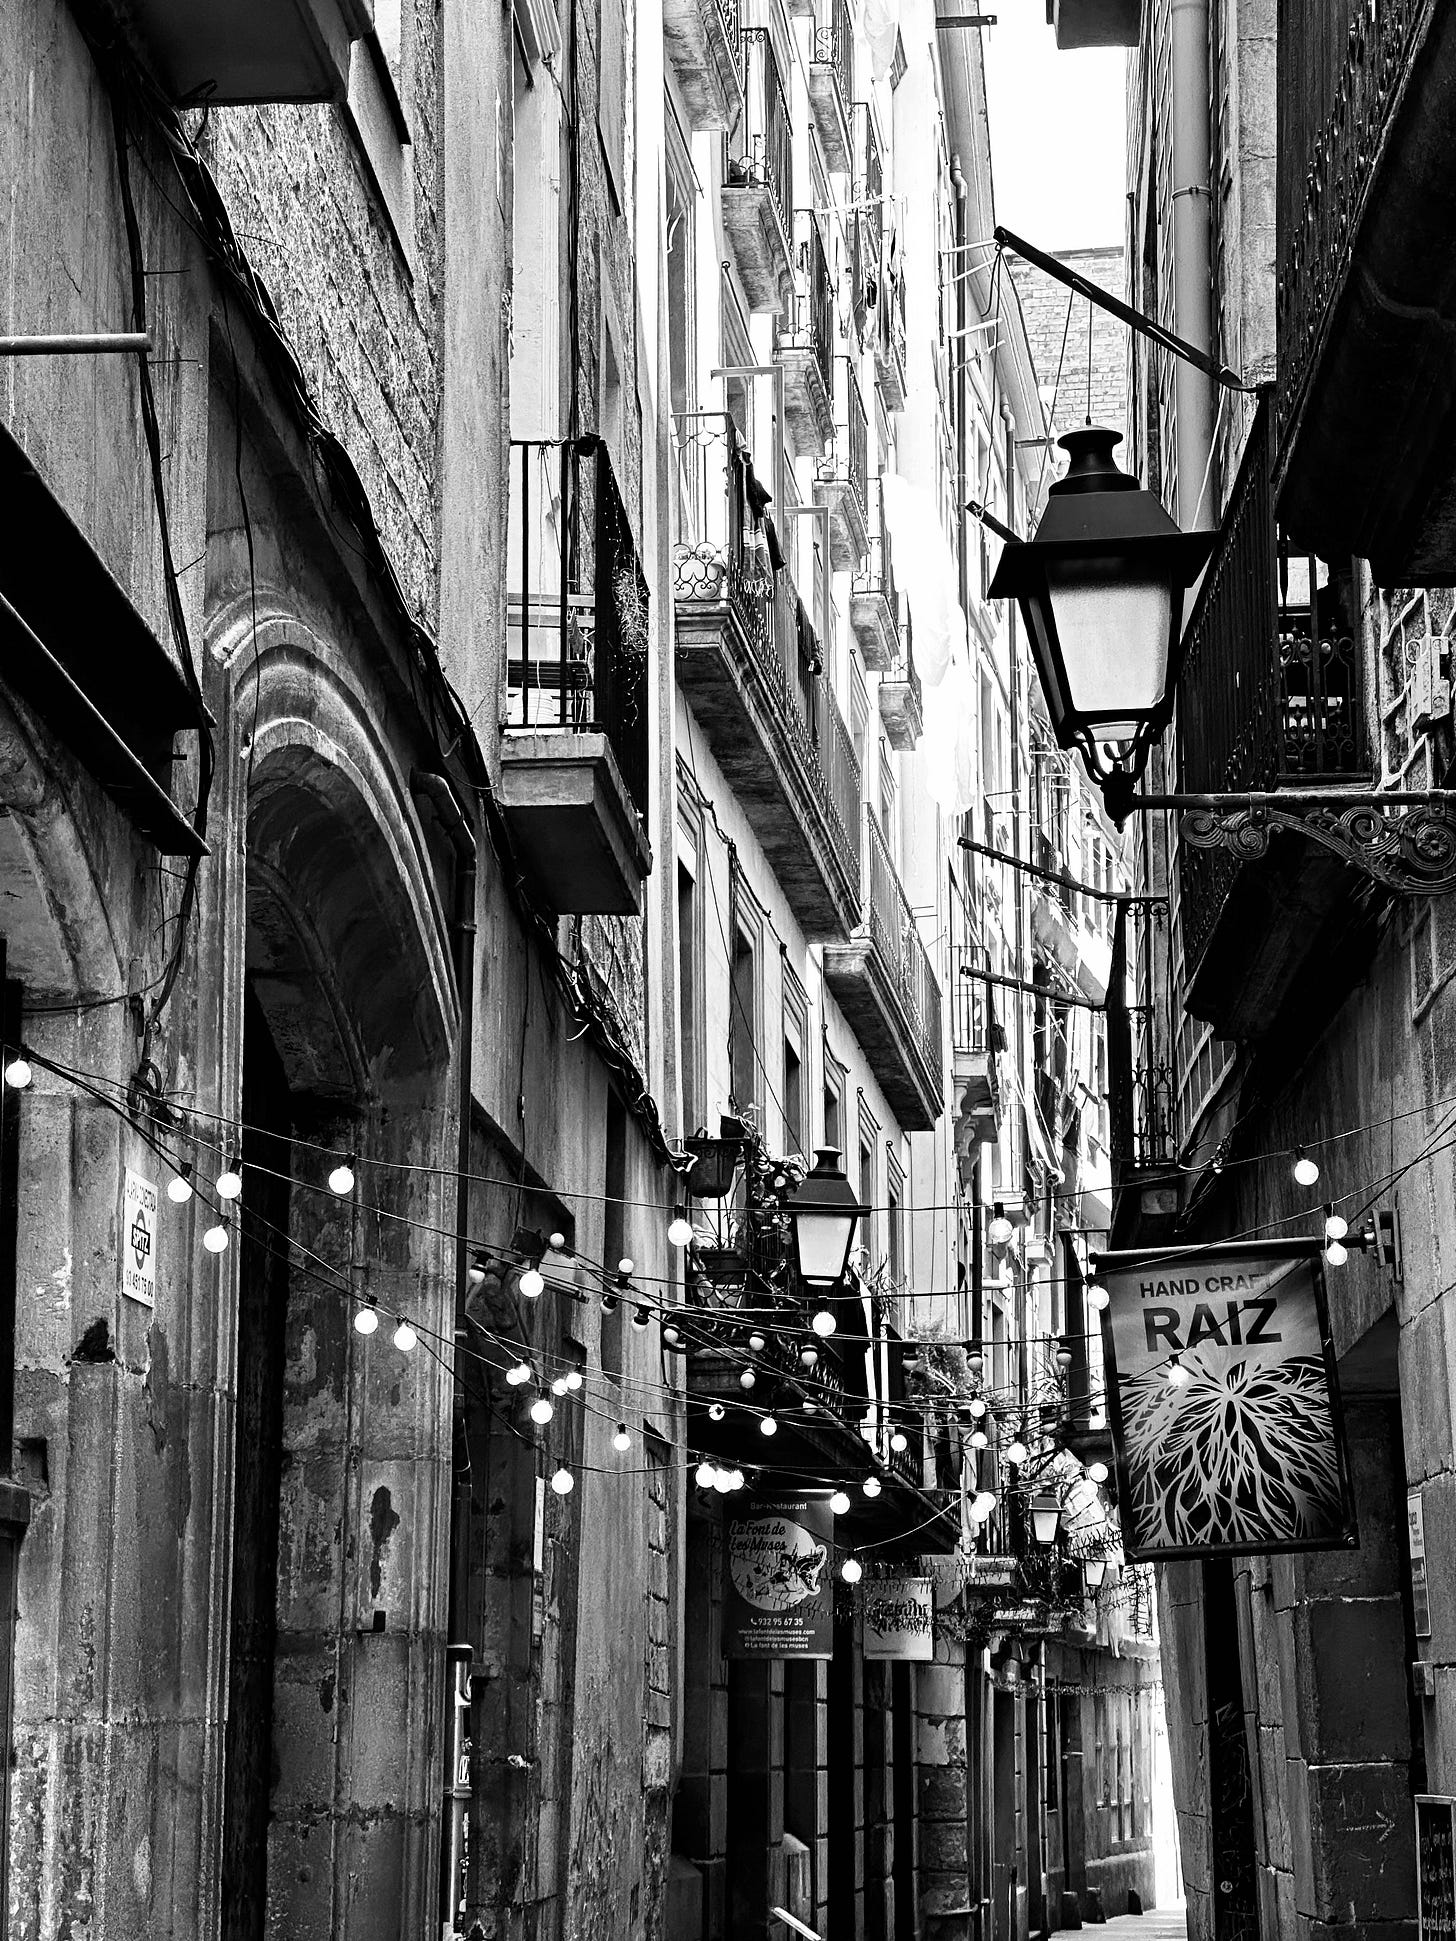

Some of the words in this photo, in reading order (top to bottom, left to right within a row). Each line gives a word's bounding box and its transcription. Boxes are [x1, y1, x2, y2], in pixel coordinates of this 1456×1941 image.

[132, 1226, 149, 1253] SPITZ
[1140, 1278, 1200, 1299] HAND
[1143, 1297, 1282, 1353] RAIZ
[731, 1521, 744, 1536] La
[746, 1521, 770, 1536] Font
[772, 1521, 786, 1536] de
[731, 1539, 751, 1552] Les
[750, 1538, 787, 1553] Muses
[758, 1617, 771, 1626] 932
[773, 1617, 782, 1626] 95
[783, 1617, 793, 1626] 67
[794, 1617, 804, 1626] 35
